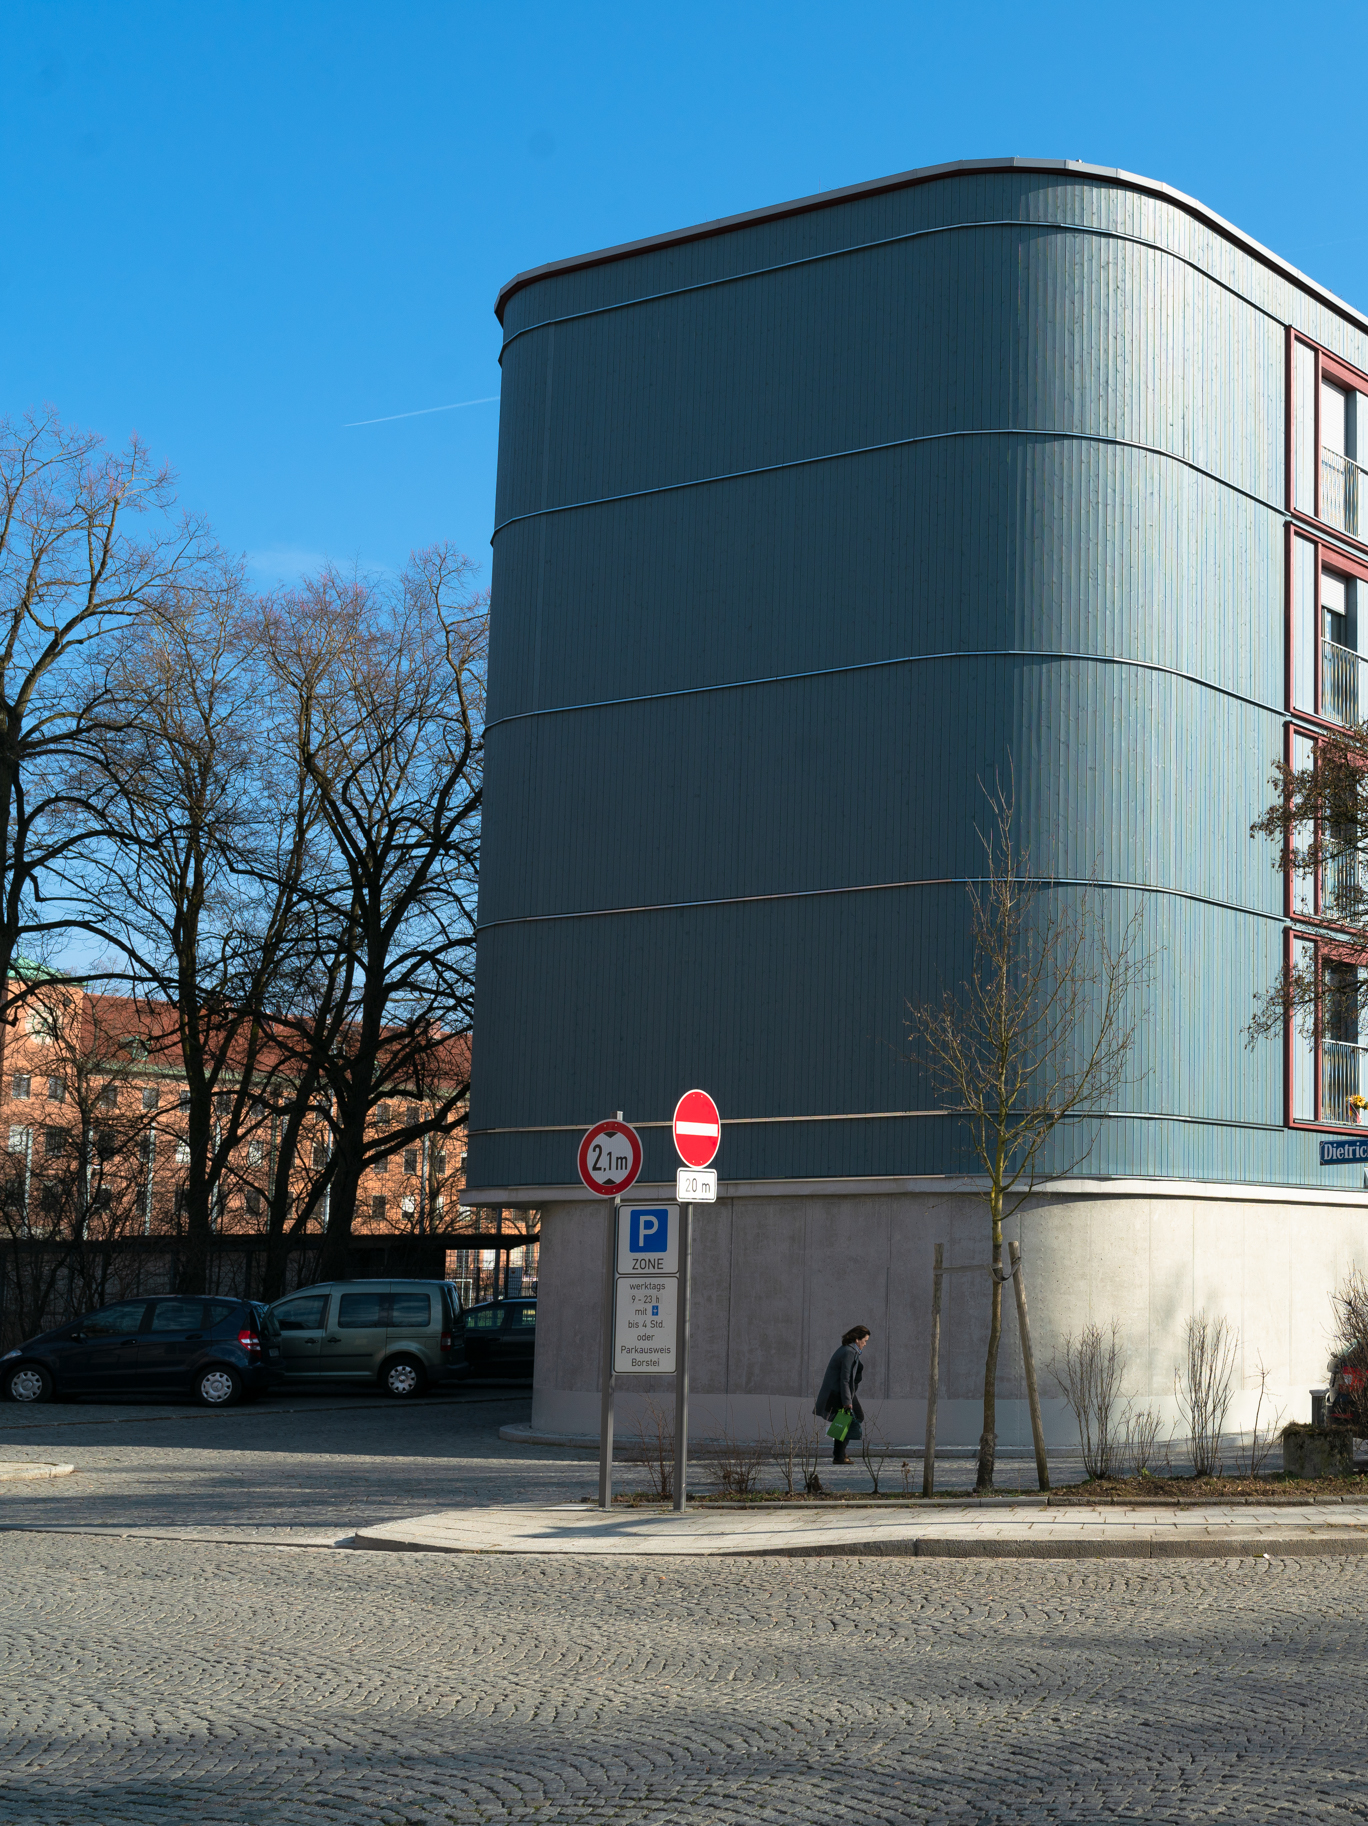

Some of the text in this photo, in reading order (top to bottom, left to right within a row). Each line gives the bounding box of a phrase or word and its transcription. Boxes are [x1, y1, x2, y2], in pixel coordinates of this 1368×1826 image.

[591, 1144, 628, 1172] 2,1 m
[685, 1178, 711, 1193] 20 m
[639, 1215, 659, 1247] P
[632, 1258, 664, 1270] ZONE
[629, 1282, 666, 1292] werktags
[631, 1295, 636, 1304] 9
[643, 1295, 653, 1304] 23
[655, 1295, 660, 1304] h
[634, 1307, 648, 1316] mit
[628, 1320, 665, 1329] bis 4 Std.
[636, 1333, 655, 1341] oder
[620, 1345, 671, 1354] Parkausweis
[631, 1358, 660, 1367] Borstei
